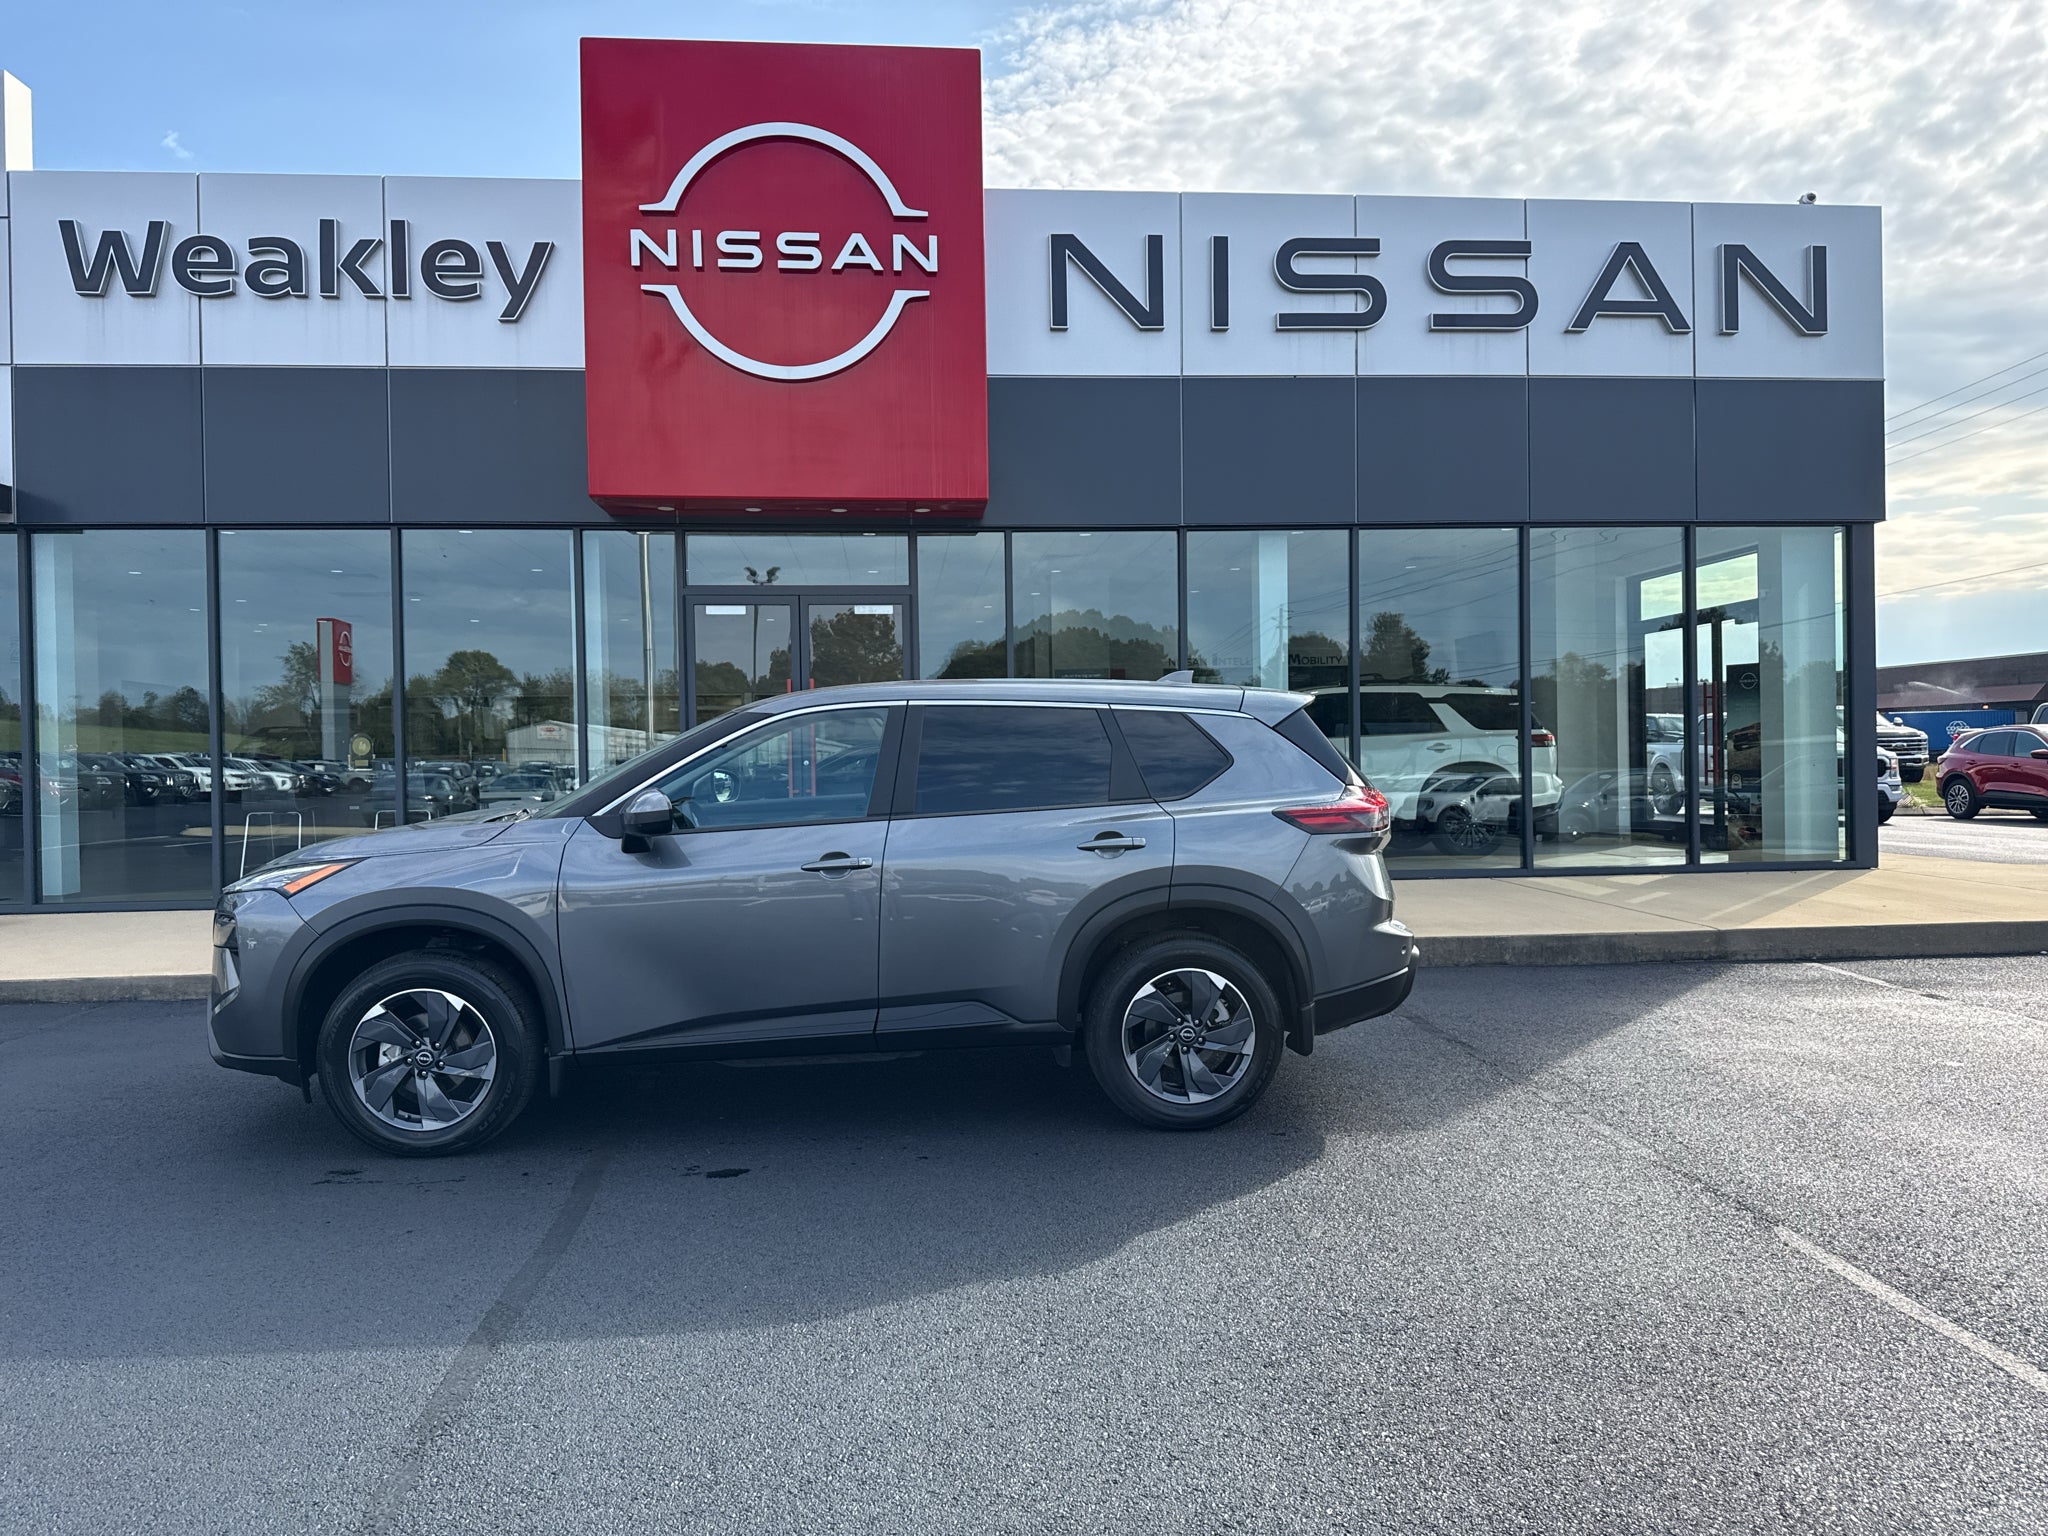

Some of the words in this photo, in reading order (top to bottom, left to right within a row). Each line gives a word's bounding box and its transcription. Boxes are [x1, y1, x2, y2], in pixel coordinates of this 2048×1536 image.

[58, 218, 556, 322] Weakley
[630, 228, 939, 274] NISSAN
[1047, 232, 1829, 337] NISSAN
[1168, 657, 1207, 667] NSAN
